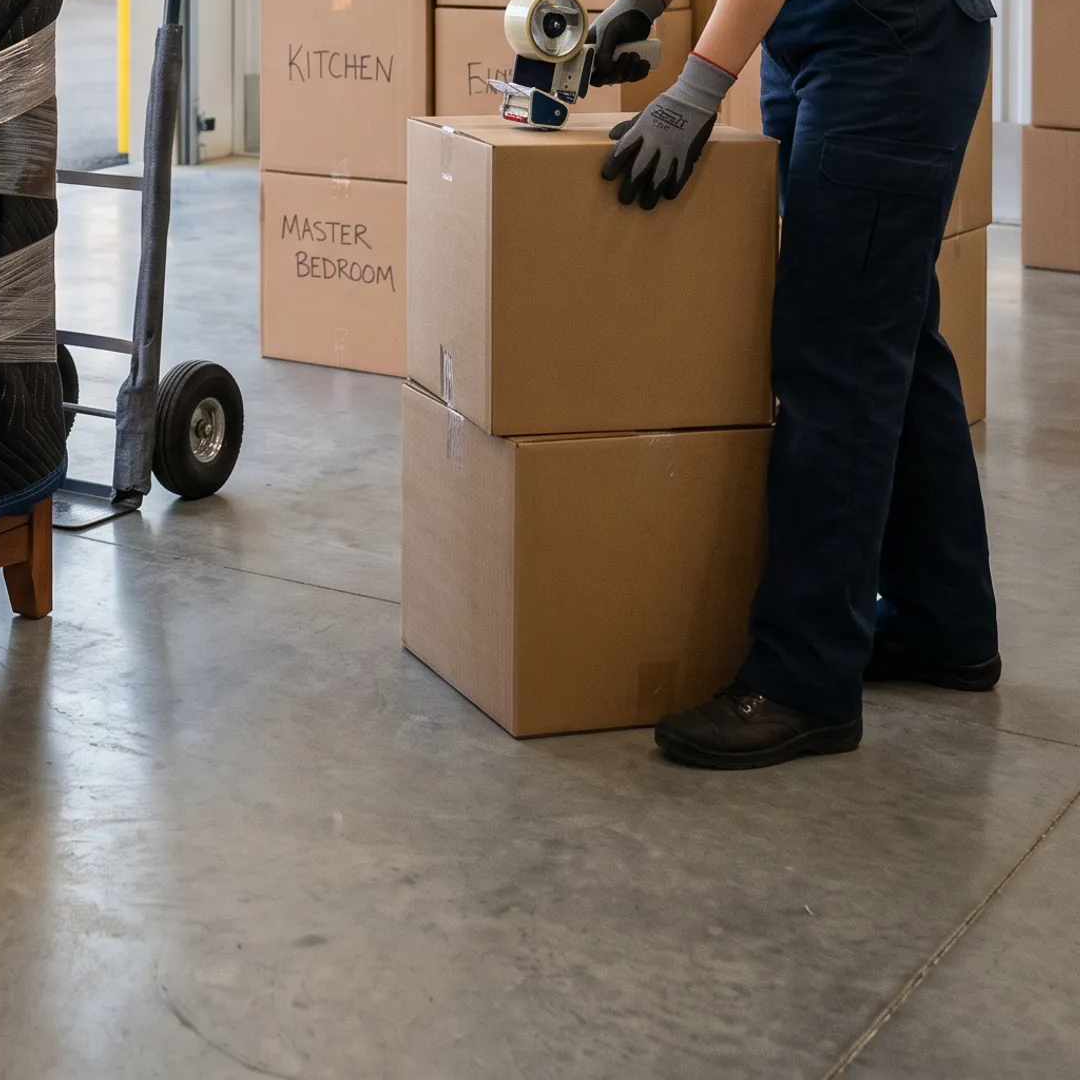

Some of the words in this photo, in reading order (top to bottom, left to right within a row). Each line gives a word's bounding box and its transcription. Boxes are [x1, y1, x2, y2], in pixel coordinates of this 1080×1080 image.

[288, 43, 394, 83] KITCHEN
[281, 213, 373, 250] MASTER
[295, 250, 396, 293] BEDROOM
